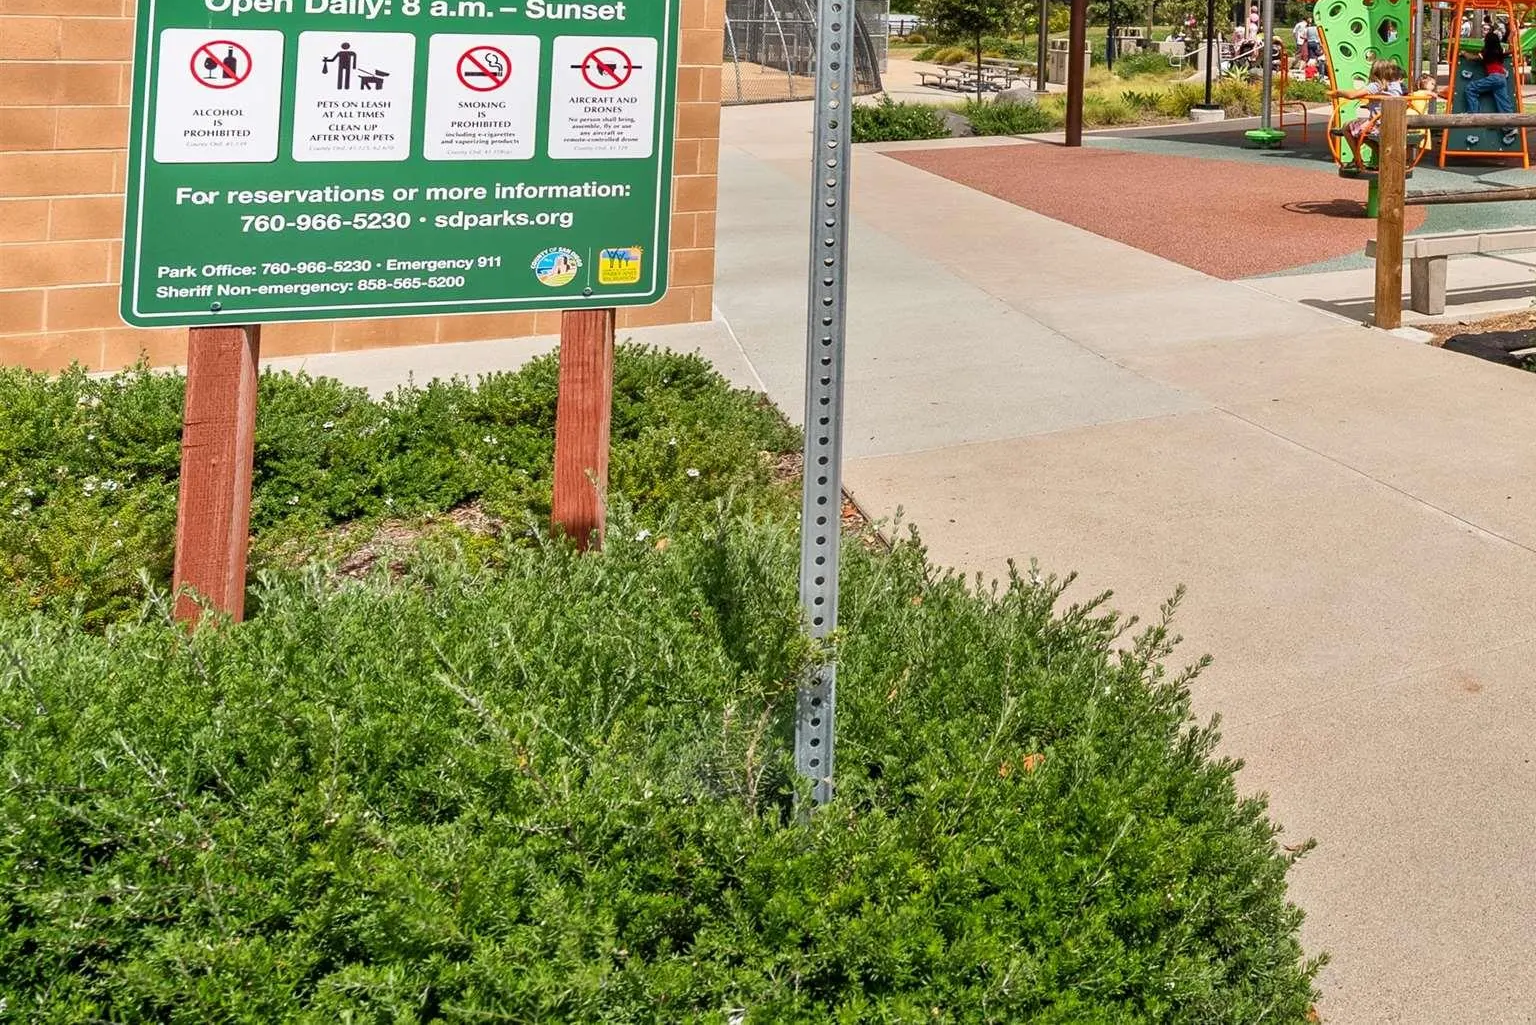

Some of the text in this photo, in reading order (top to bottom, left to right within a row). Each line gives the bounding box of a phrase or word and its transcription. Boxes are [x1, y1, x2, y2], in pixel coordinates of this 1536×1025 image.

[430, 0, 494, 18] a.m.
[193, 109, 244, 117] ALCOHOL
[458, 101, 506, 109] SMOKING
[213, 119, 223, 127] IS
[183, 129, 251, 137] PROHIBITED
[176, 182, 631, 205] For reservations or more information:
[241, 212, 411, 233] 760-966-5230
[434, 210, 574, 230] sdparks.org
[157, 266, 197, 279] Park
[202, 264, 257, 277] Office:
[261, 260, 372, 275] 760-966-5230
[386, 257, 473, 272] Emergency
[477, 256, 502, 268] 911
[156, 276, 466, 299] Sheriff Non-emergency: 858-565-5200
